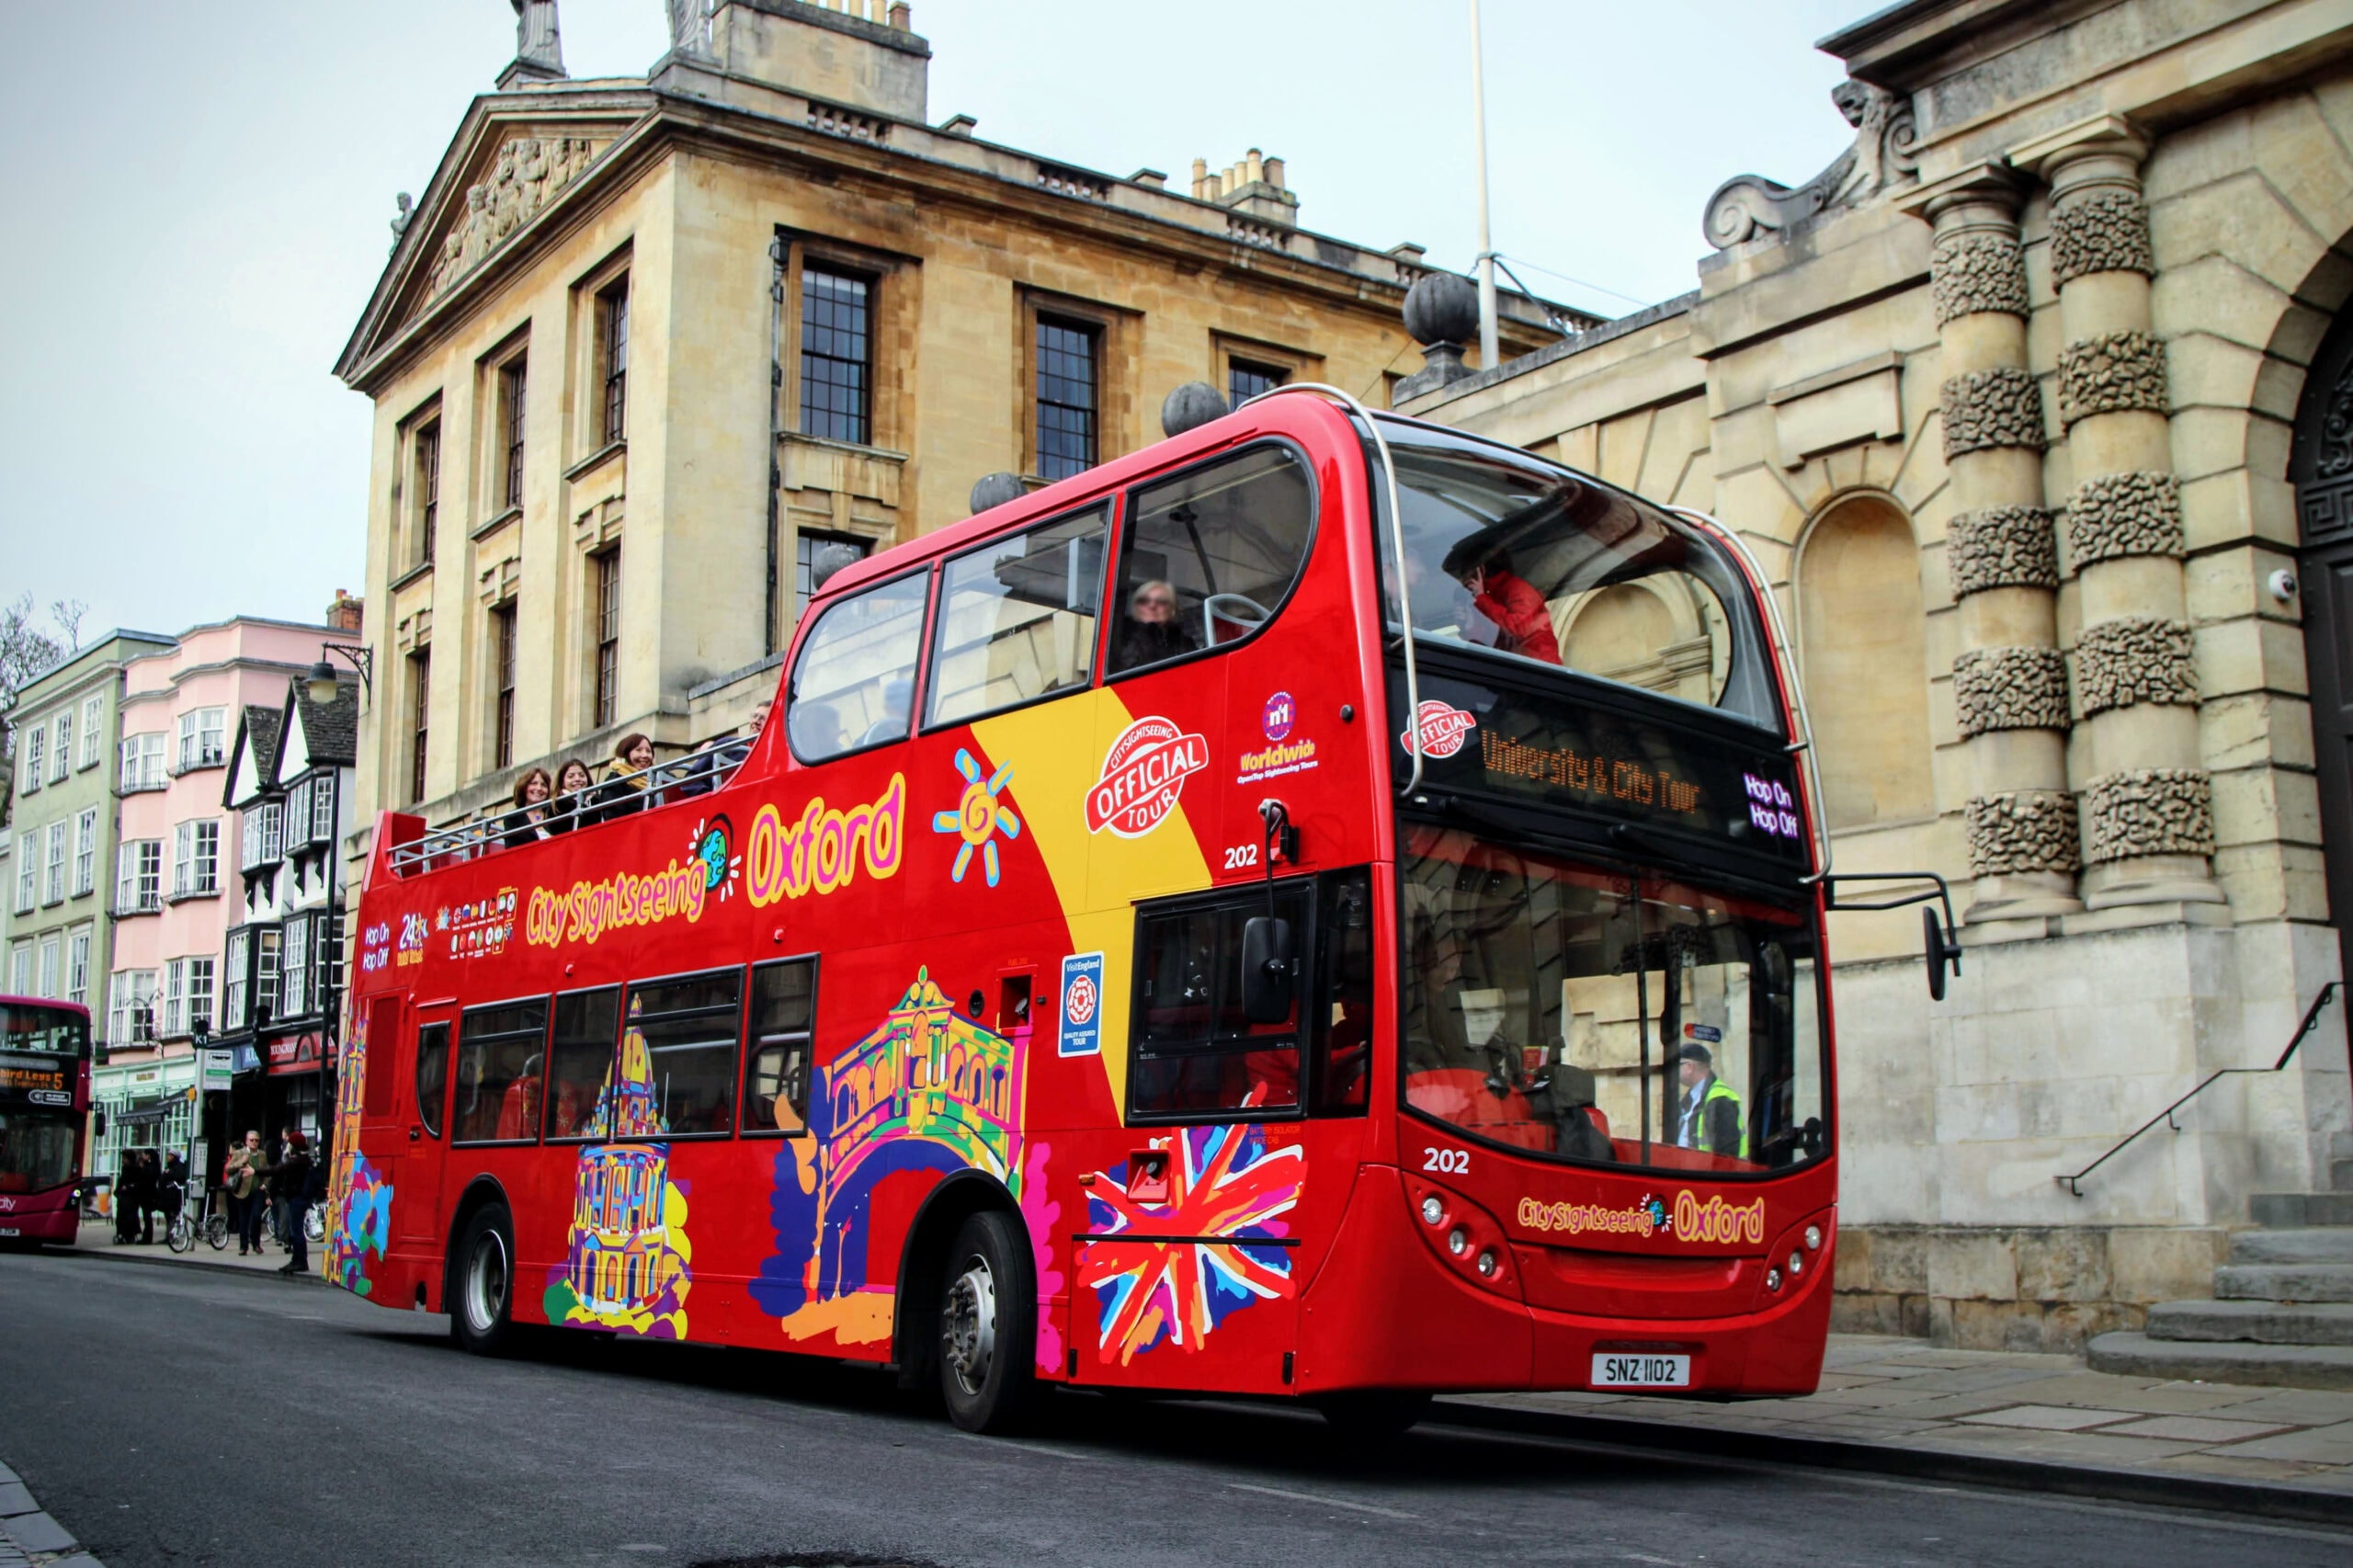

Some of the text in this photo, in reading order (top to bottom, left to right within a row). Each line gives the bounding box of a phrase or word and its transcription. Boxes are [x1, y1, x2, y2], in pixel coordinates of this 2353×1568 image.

[1409, 713, 1472, 746] FFICIAL
[1109, 724, 1173, 769] CITYSIGHTSEEING
[1434, 735, 1461, 754] TOUR
[1097, 741, 1200, 820] OFFICIAL
[1482, 730, 1700, 815] University & City Tour
[1743, 772, 1793, 810] Hop On
[1127, 788, 1175, 828] TOUR
[1749, 801, 1798, 839] Hop Off
[526, 772, 906, 949] CitySightseeing Oxford
[1224, 844, 1257, 869] 202
[365, 922, 390, 947] Hop On
[362, 951, 376, 971] Hop
[377, 947, 390, 969] Off
[1066, 958, 1099, 972] VisitEngland
[195, 1035, 208, 1045] K1
[1073, 1038, 1086, 1046] TOUR
[53, 1073, 63, 1090] 5
[1423, 1147, 1469, 1174] 202
[1518, 1189, 1764, 1244] CitySightseeing Oxford
[1605, 1358, 1640, 1381] SNZ
